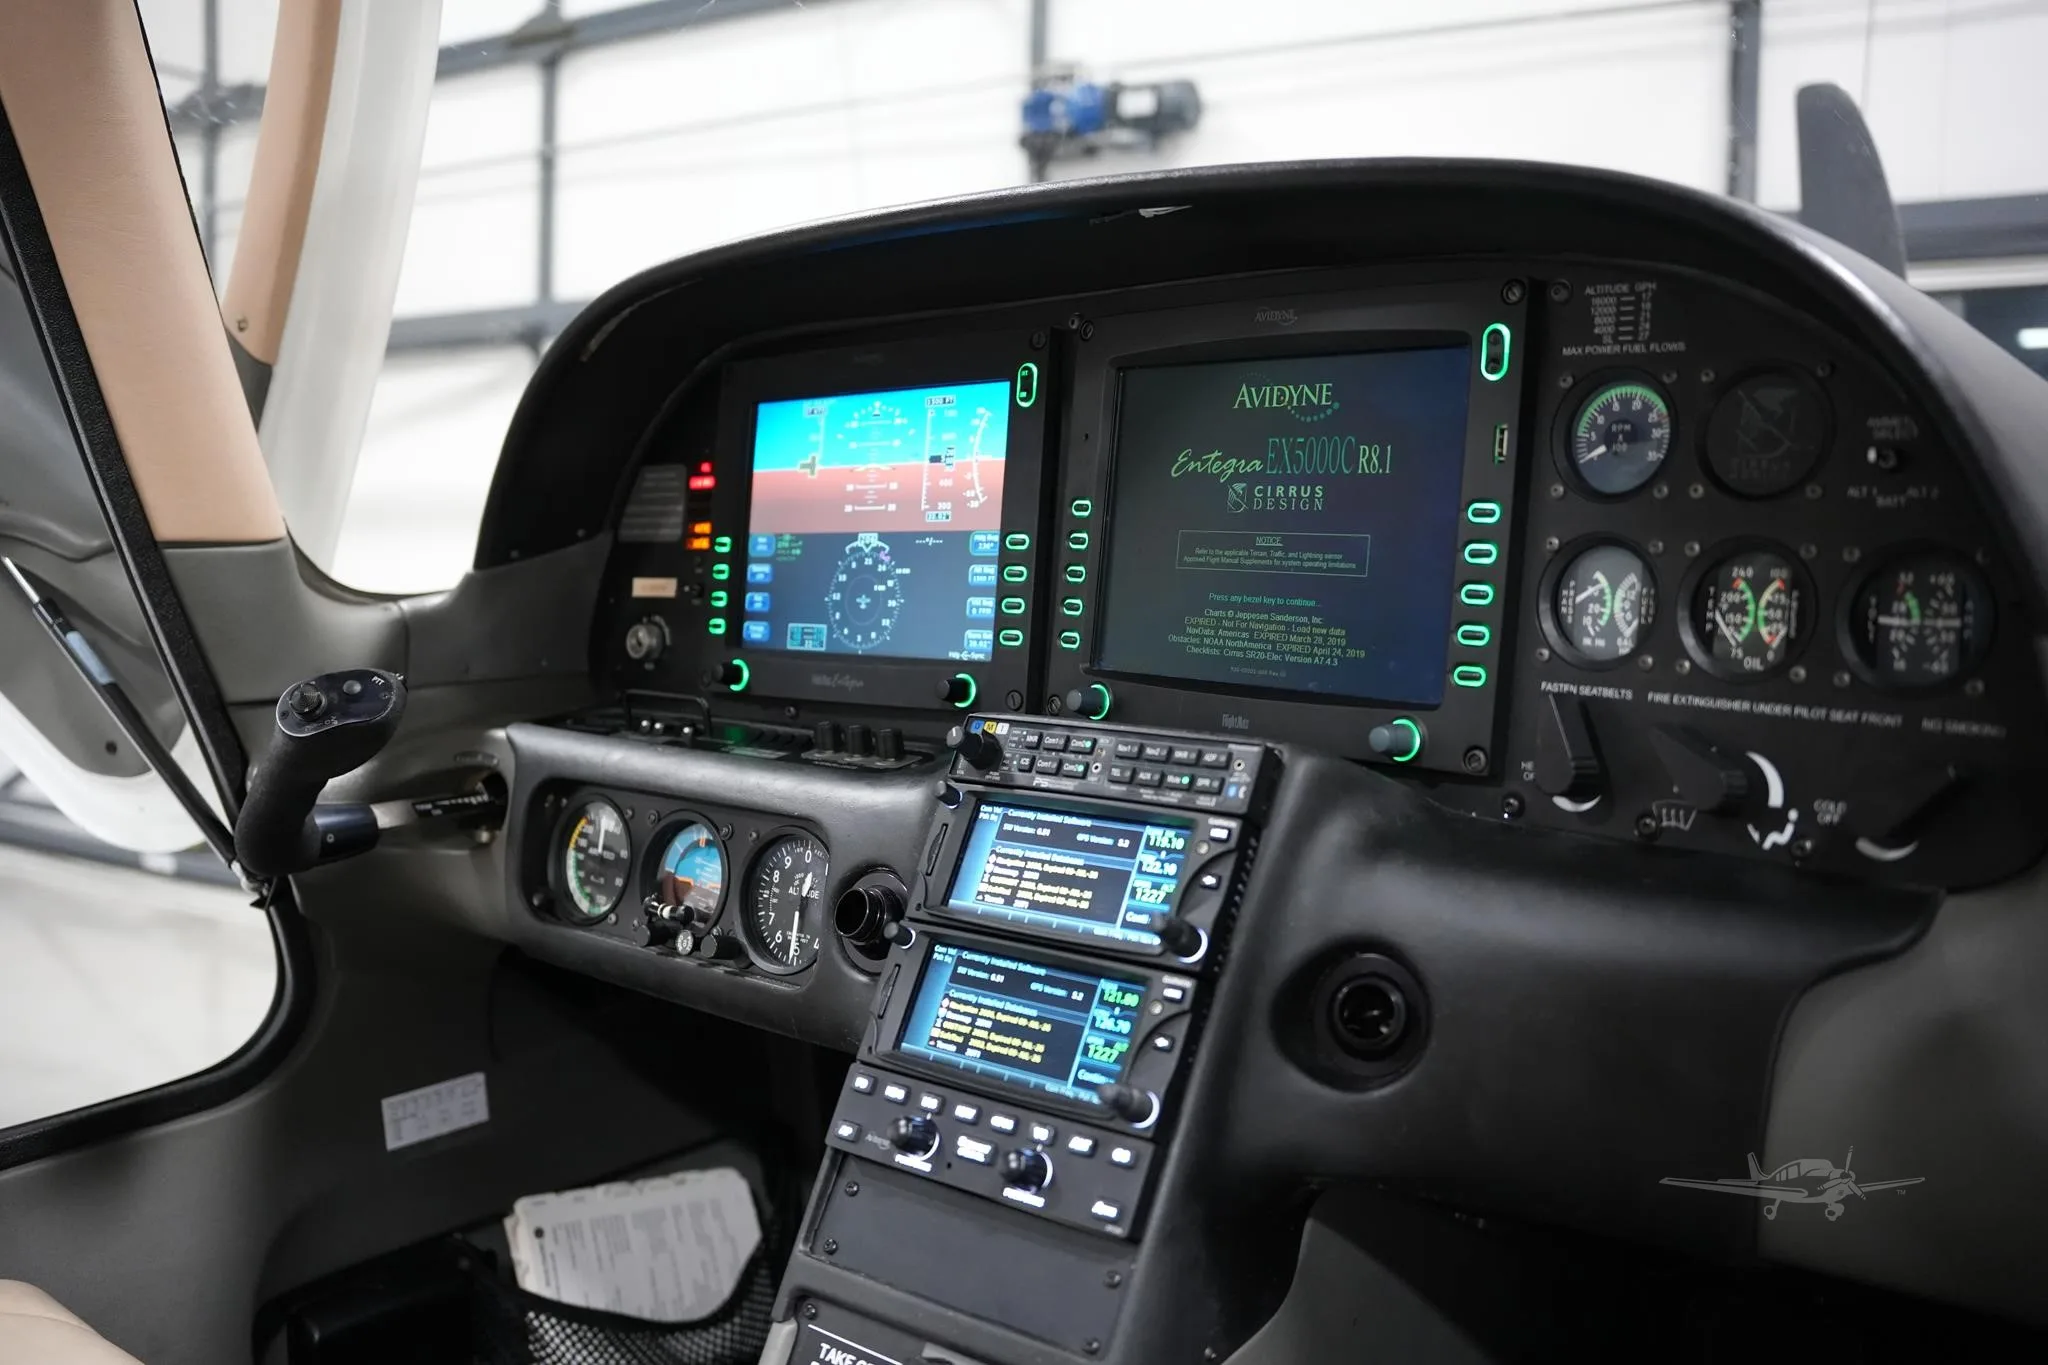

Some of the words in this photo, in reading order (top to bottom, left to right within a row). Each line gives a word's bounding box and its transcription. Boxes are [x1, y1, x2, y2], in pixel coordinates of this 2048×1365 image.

[1584, 284, 1630, 296] ALTITUDE
[1562, 345, 1583, 356] MAX
[1585, 344, 1621, 355] POWER
[1623, 343, 1647, 354] FUEL
[1233, 383, 1333, 409] AVIDYNE
[1611, 424, 1631, 432] RPM
[1171, 449, 1263, 482] Entegra
[1266, 436, 1355, 475] EX5000C
[1357, 445, 1392, 474] R8.1
[1254, 485, 1324, 498] CIRRUS
[1253, 498, 1324, 511] DESIGN
[1256, 536, 1283, 546] NOTICE
[1732, 566, 1754, 578] 240
[1208, 593, 1228, 601] Press
[1263, 596, 1276, 605] key
[1721, 591, 1741, 602] 200
[1204, 608, 1226, 617] Charts
[1235, 610, 1269, 620] Jeppesen
[1184, 616, 1217, 626] EXPIRED
[1235, 620, 1248, 628] For
[1249, 621, 1286, 631] Navigation
[1292, 624, 1311, 634] Load
[1329, 627, 1346, 635] data
[1217, 629, 1250, 638] Americas
[1253, 631, 1287, 641] EXPIRED
[1289, 634, 1312, 643] March
[1327, 637, 1346, 647] 2019
[1203, 637, 1224, 646] NOAA
[1225, 639, 1272, 650] NorthAmerica
[1276, 643, 1311, 654] EXPIRED
[1312, 646, 1330, 656] April
[1346, 649, 1365, 658] 2019
[1223, 649, 1244, 658] Cirrus
[1245, 650, 1282, 661] SR20-Elec
[1284, 654, 1312, 664] Version
[1743, 656, 1765, 671] OIL
[371, 675, 385, 686] PTT
[1540, 681, 1578, 695] FASTEN
[1579, 685, 1633, 701] SEATBELTS
[1648, 691, 1671, 705] FIRE
[1672, 693, 1750, 712] EXTINGUISHER
[1752, 701, 1792, 716] UNDER
[1793, 705, 1828, 721] PILOT
[1829, 708, 1859, 723] SEAT
[1861, 711, 1903, 728] FRONT
[1020, 758, 1030, 766] ICS
[1813, 798, 1847, 814] COLD
[1008, 809, 1036, 820] Currently
[1036, 813, 1064, 823] Installed
[1063, 816, 1091, 827] Software
[1817, 811, 1841, 826] OFF
[805, 849, 812, 863] 0
[996, 845, 1025, 857] Currently
[1024, 850, 1052, 860] Installed
[785, 856, 792, 869] 9
[773, 870, 780, 883] 8
[1136, 887, 1166, 904] 1227
[769, 912, 775, 925] 7
[775, 930, 782, 943] 6
[793, 943, 800, 956] 5
[962, 951, 991, 965] Currently
[990, 957, 1018, 969] Installed
[1017, 962, 1047, 976] Software
[949, 989, 978, 1003] Currently
[978, 995, 1005, 1008] Installed
[1088, 1044, 1119, 1063] 1227
[820, 1343, 857, 1365] TAKE
